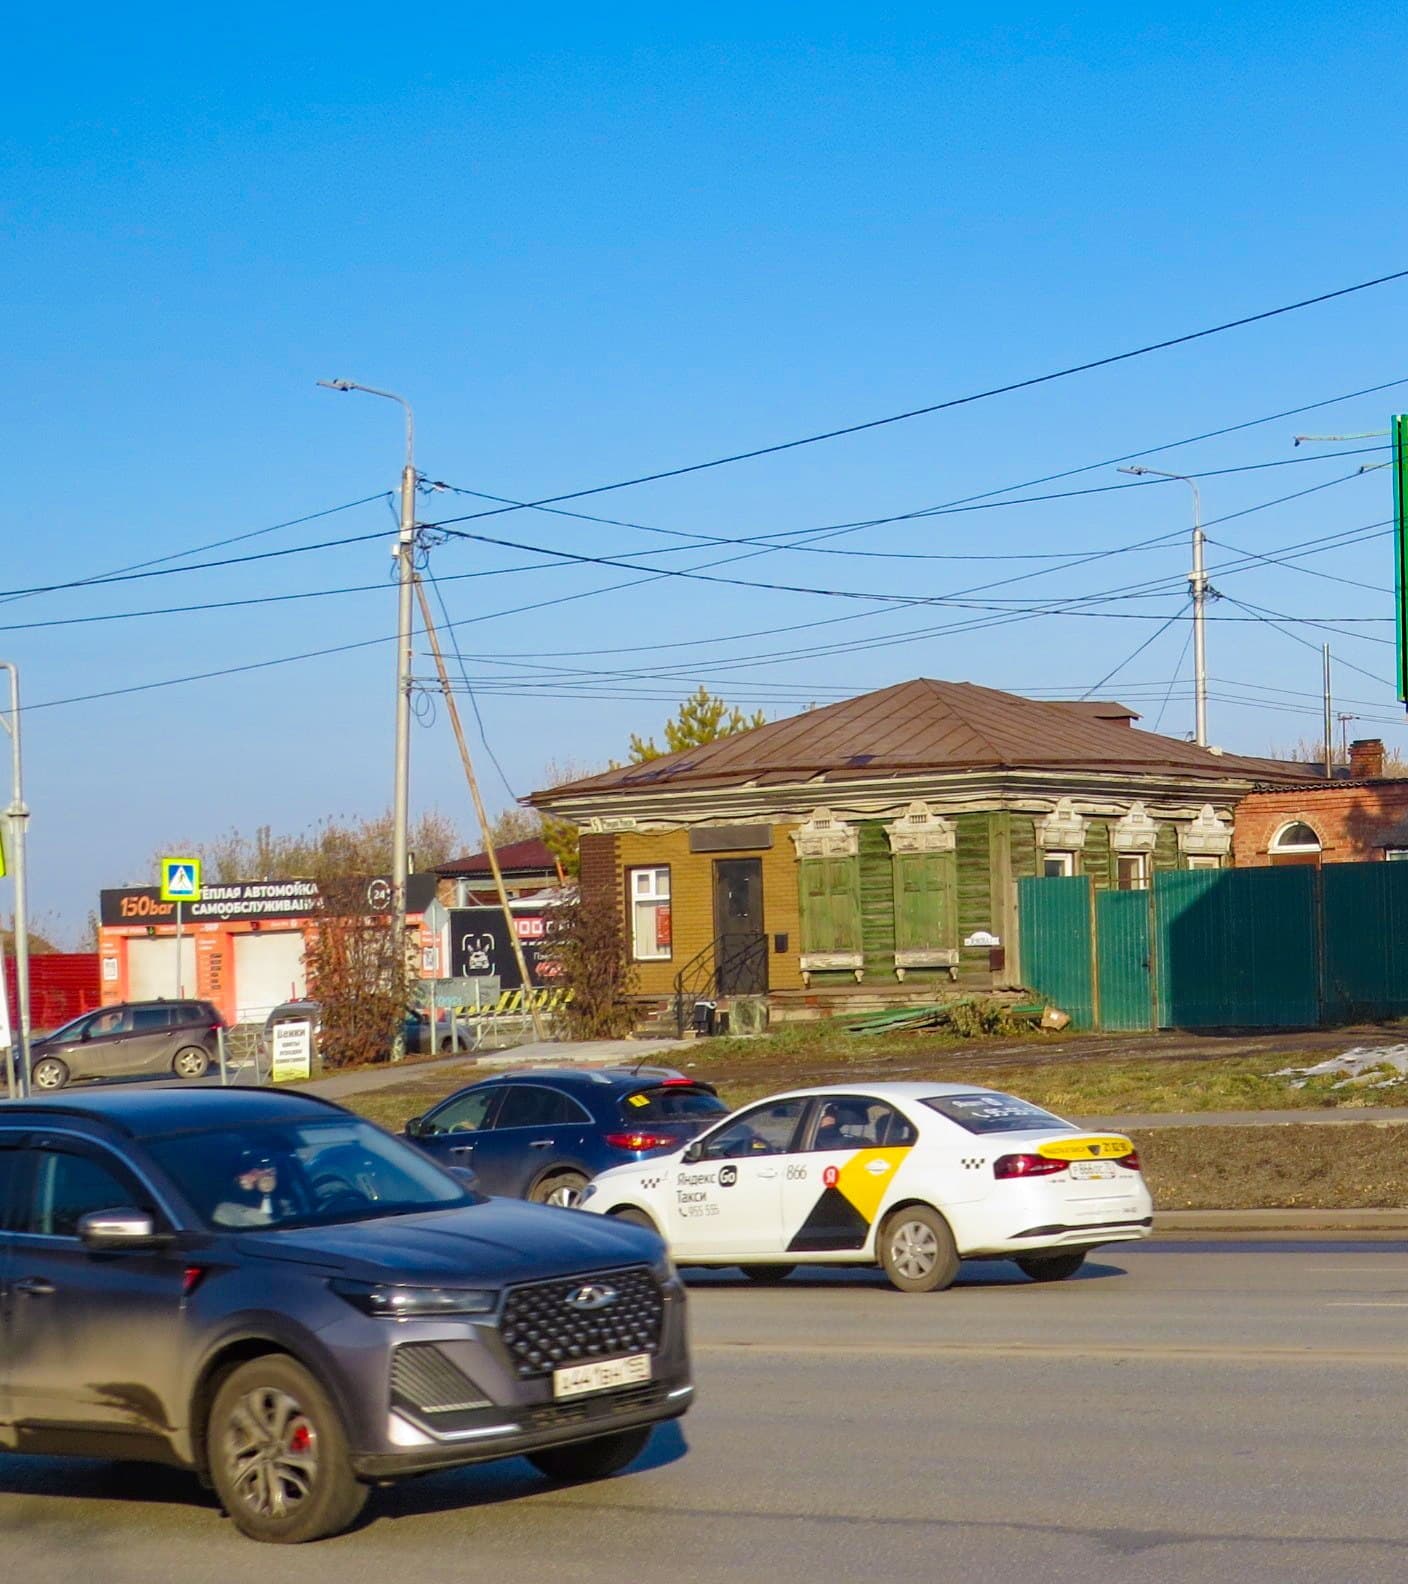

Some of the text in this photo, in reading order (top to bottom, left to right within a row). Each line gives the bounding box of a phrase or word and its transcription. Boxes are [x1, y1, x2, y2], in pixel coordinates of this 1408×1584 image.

[373, 888, 385, 901] 24
[121, 895, 175, 917] 150bar
[677, 1168, 736, 1186] Яндекс Go
[786, 1165, 807, 1180] 866
[676, 1190, 707, 1203] Такси
